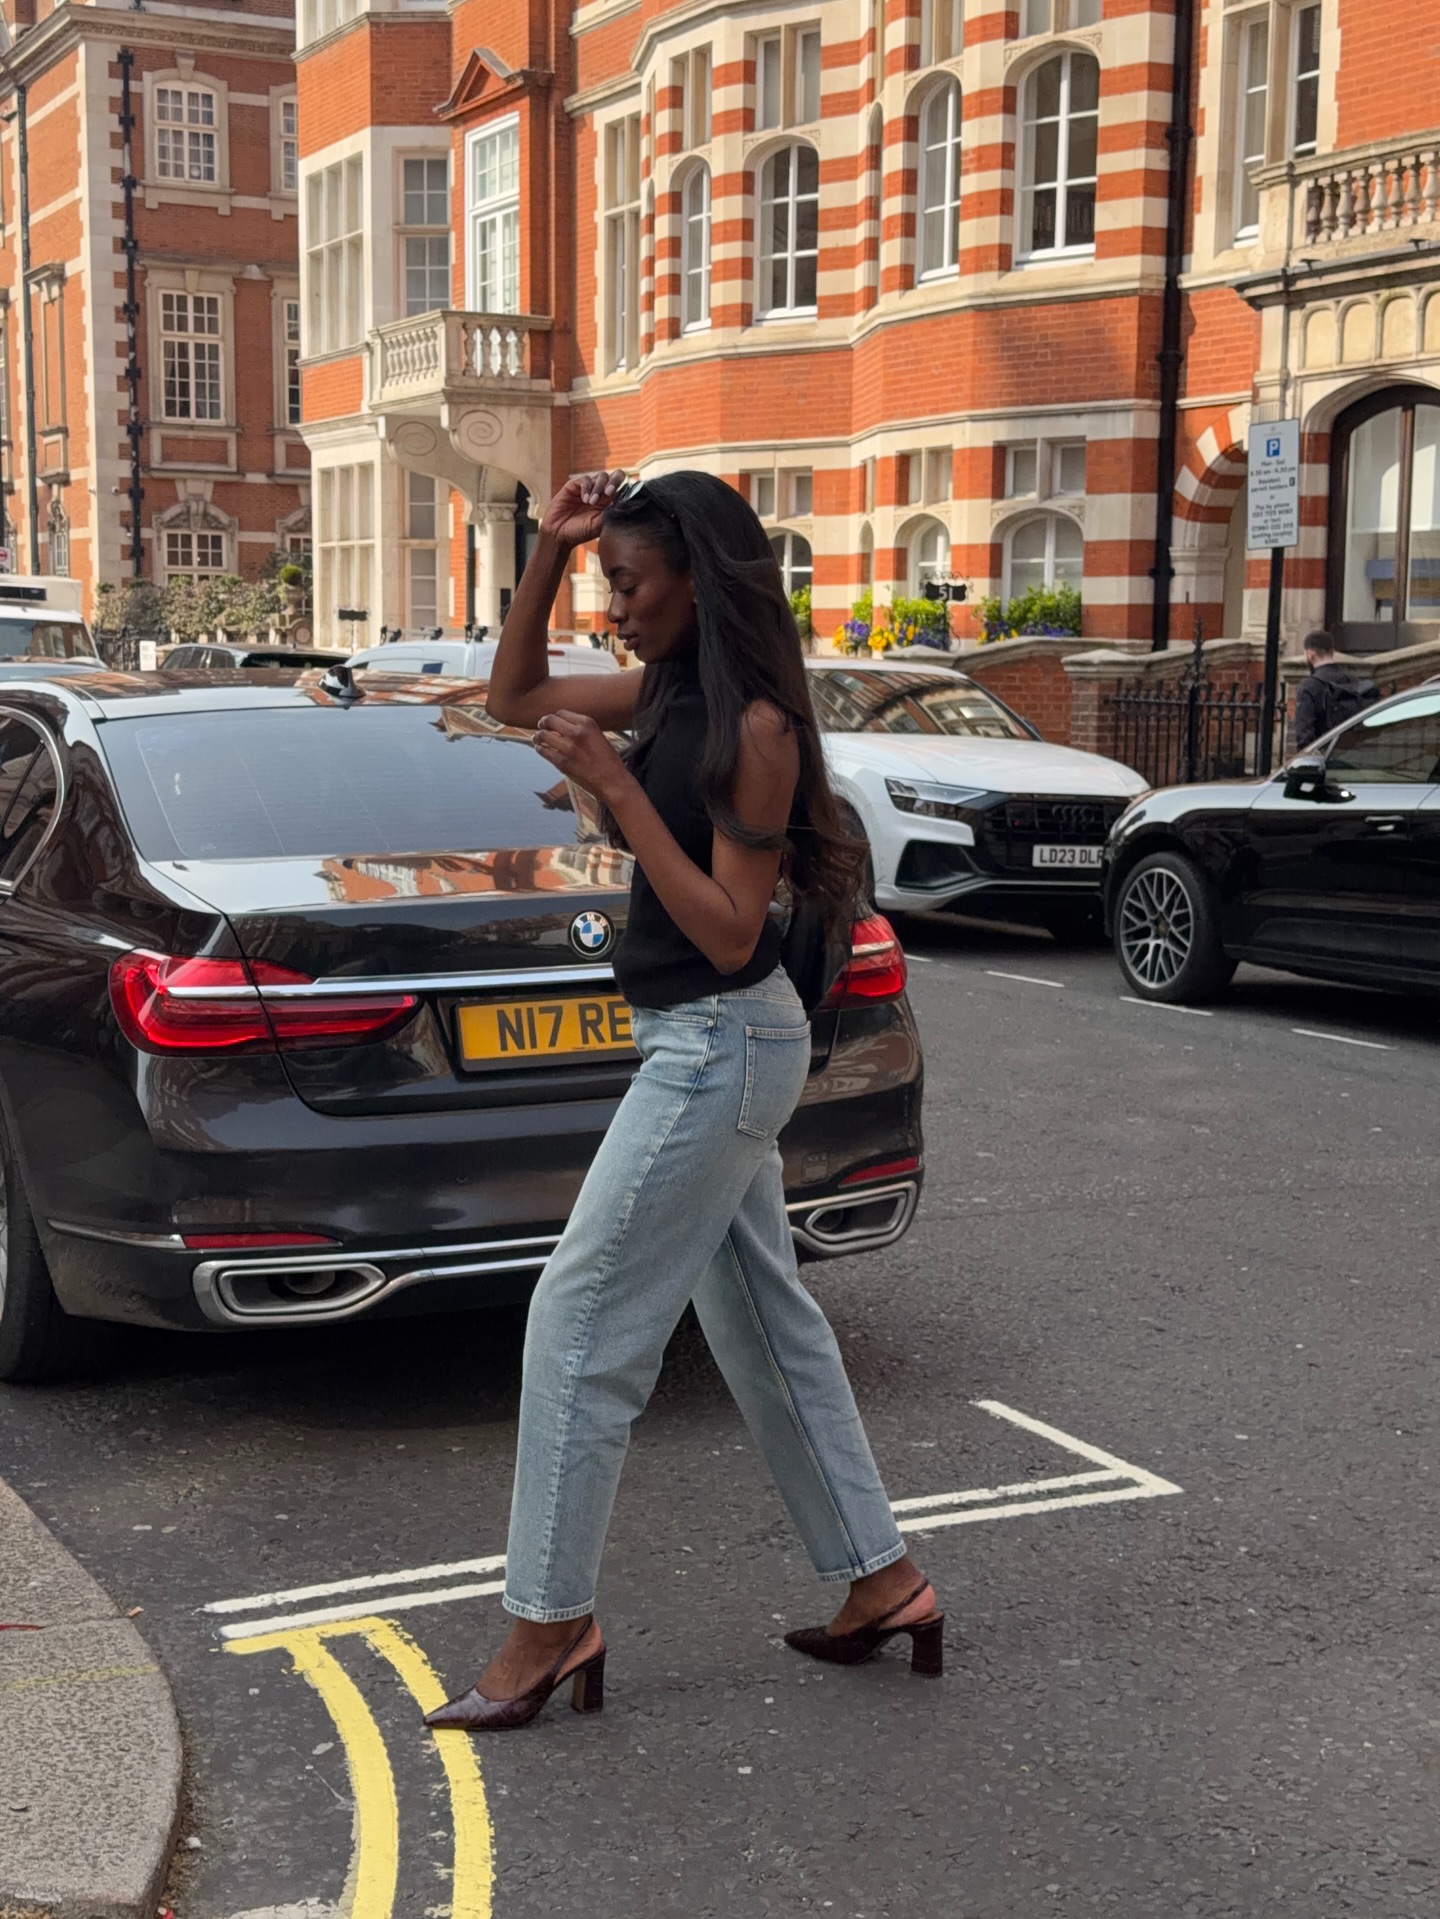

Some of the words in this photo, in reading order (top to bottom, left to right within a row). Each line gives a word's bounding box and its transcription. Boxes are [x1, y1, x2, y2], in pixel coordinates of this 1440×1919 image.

[1269, 439, 1279, 456] P
[938, 586, 953, 600] 51
[1039, 848, 1075, 864] LD23
[578, 1000, 633, 1045] RE
